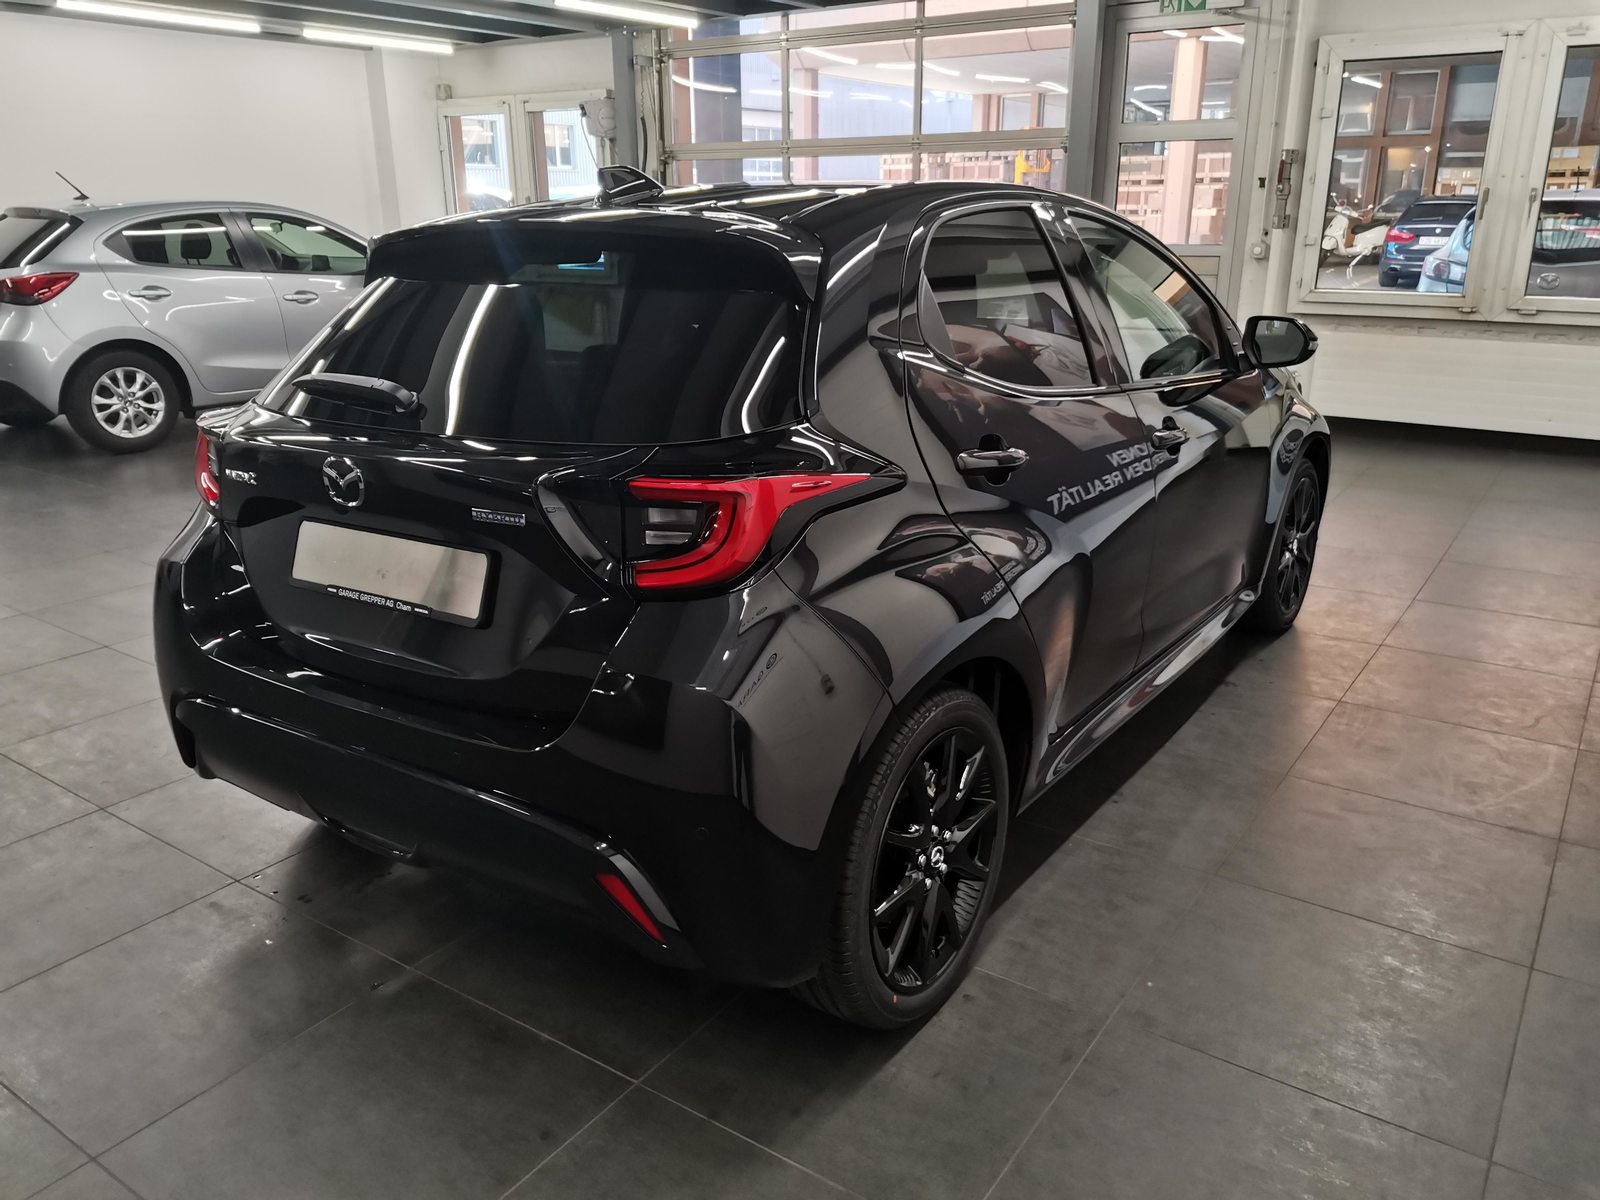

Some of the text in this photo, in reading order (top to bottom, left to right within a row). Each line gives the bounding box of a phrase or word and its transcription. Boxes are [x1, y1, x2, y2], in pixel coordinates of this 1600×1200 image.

[338, 588, 360, 600] GARAGE
[360, 593, 386, 606] GREPPER
[386, 599, 394, 608] AG
[396, 601, 412, 611] Cham
